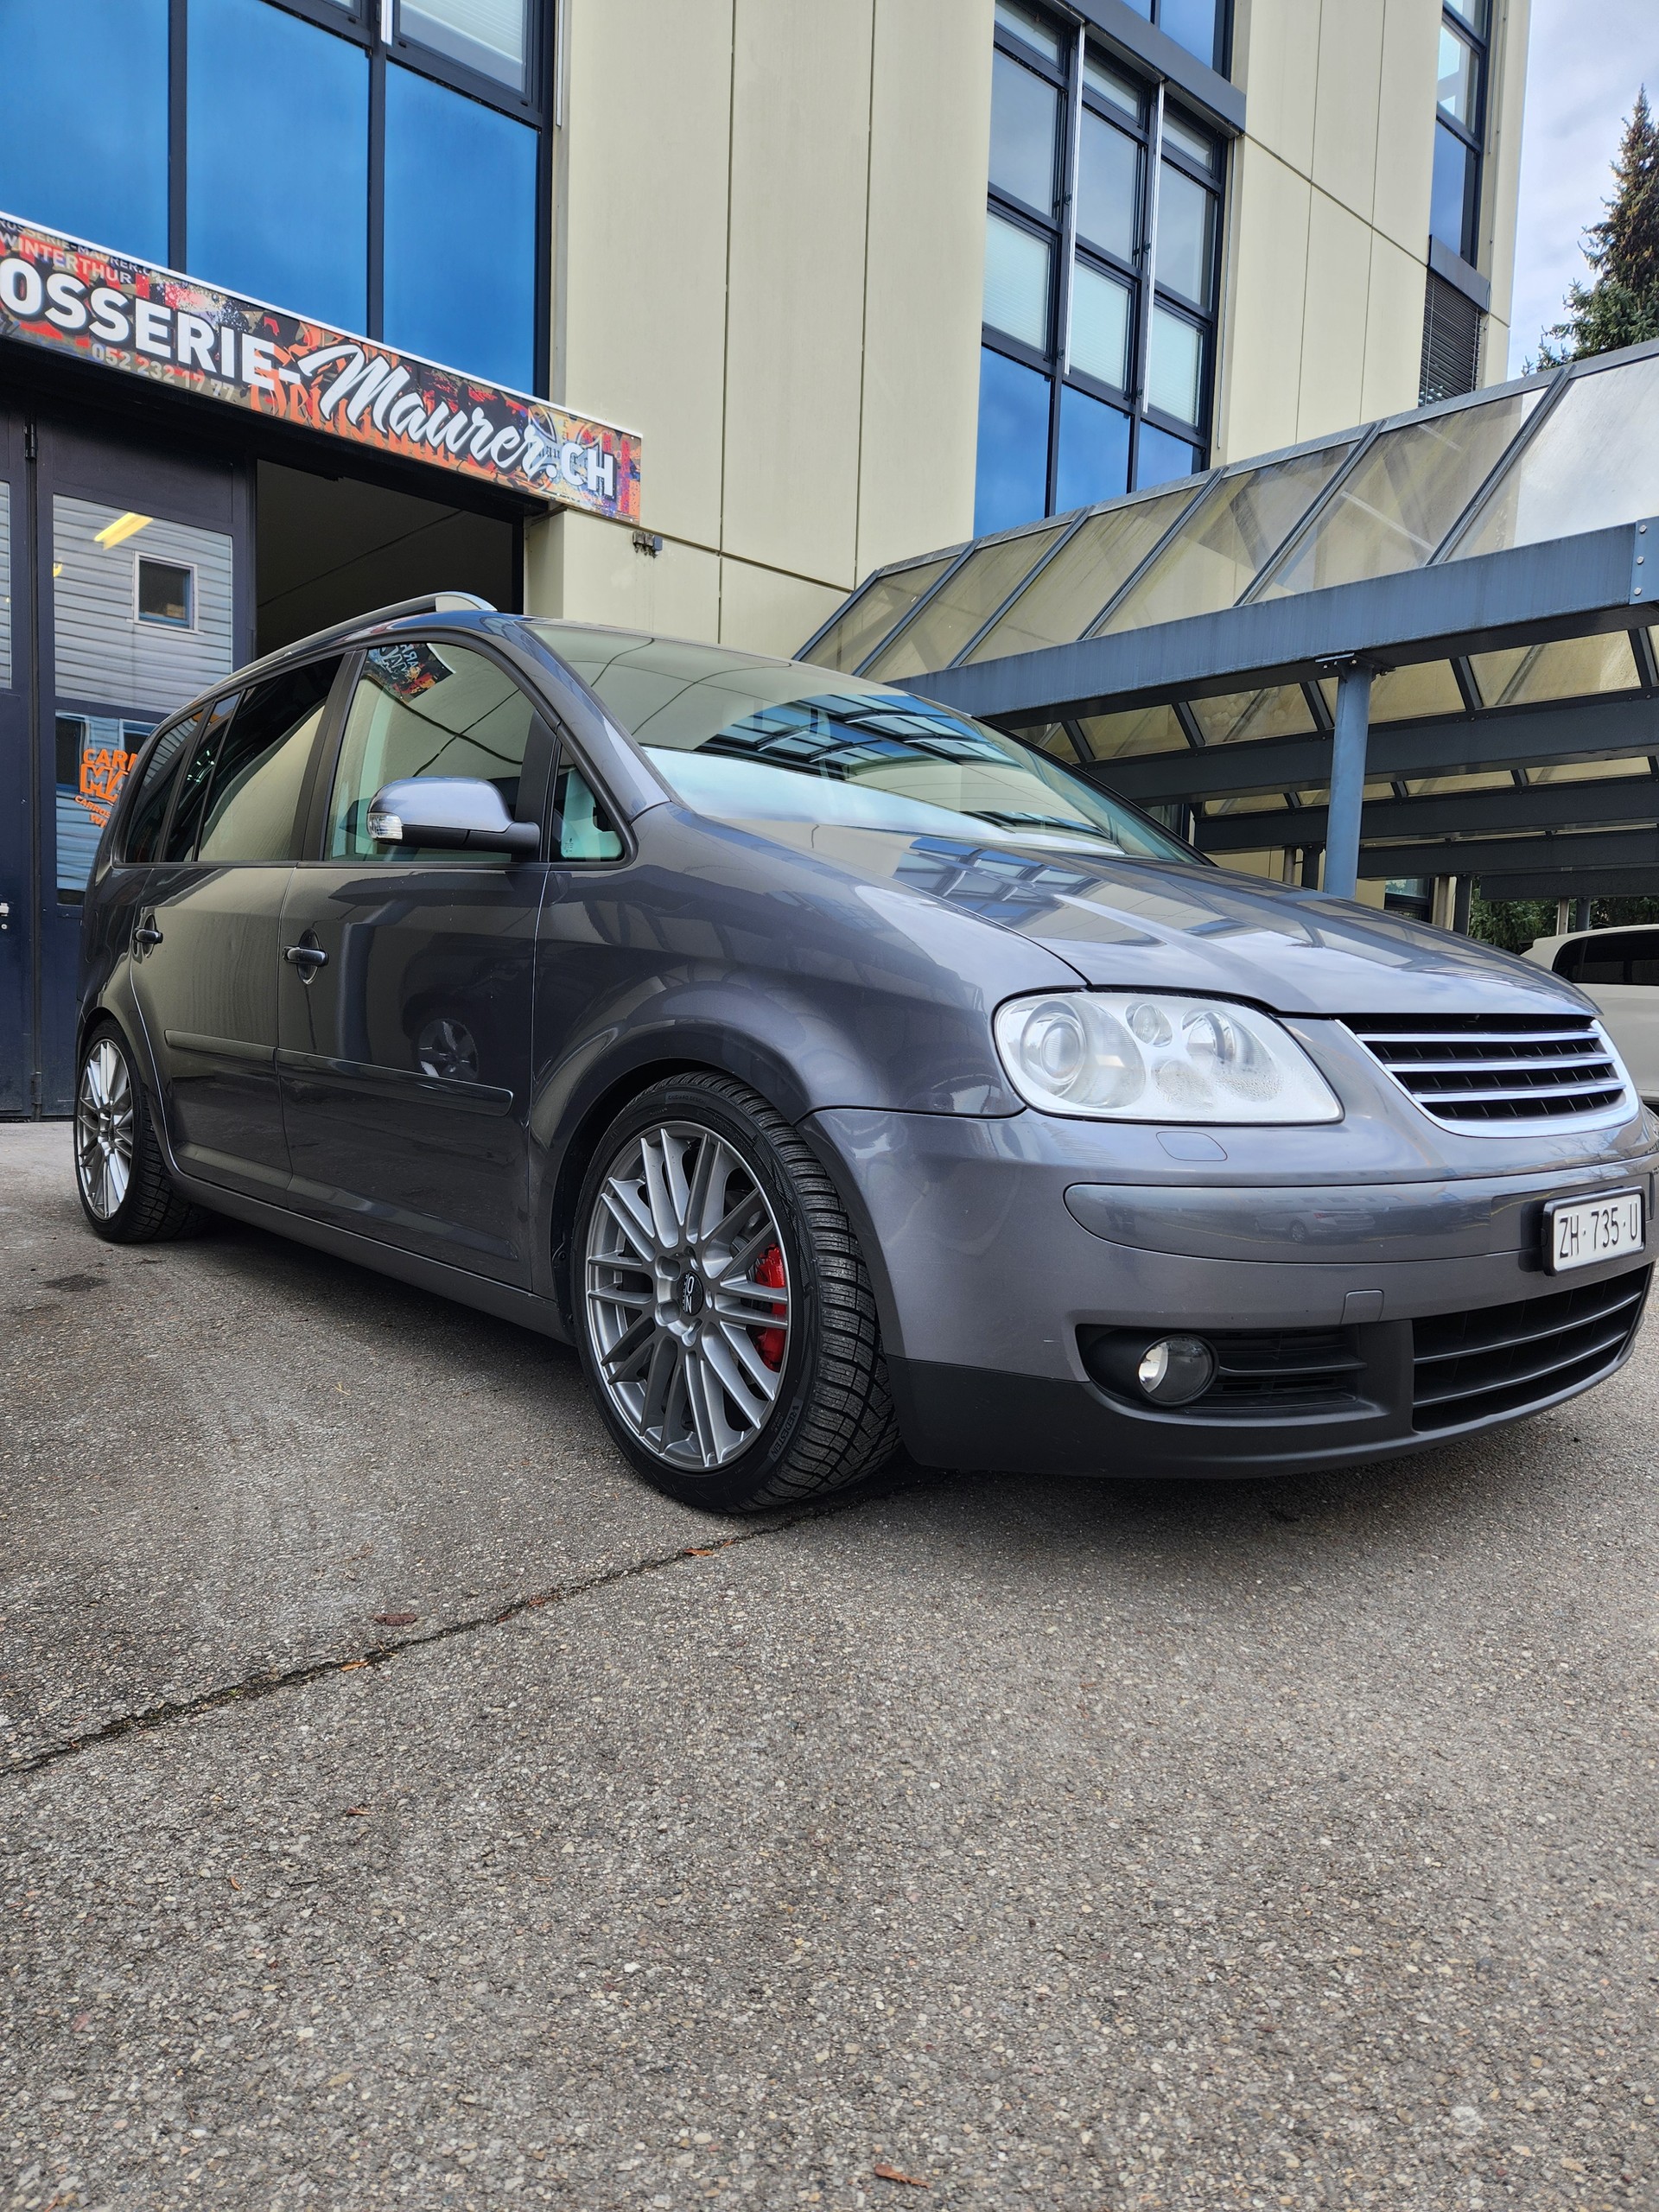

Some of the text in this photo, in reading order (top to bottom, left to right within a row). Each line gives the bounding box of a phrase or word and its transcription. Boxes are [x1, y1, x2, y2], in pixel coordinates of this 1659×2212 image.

[92, 344, 234, 401] 052 232 17 77
